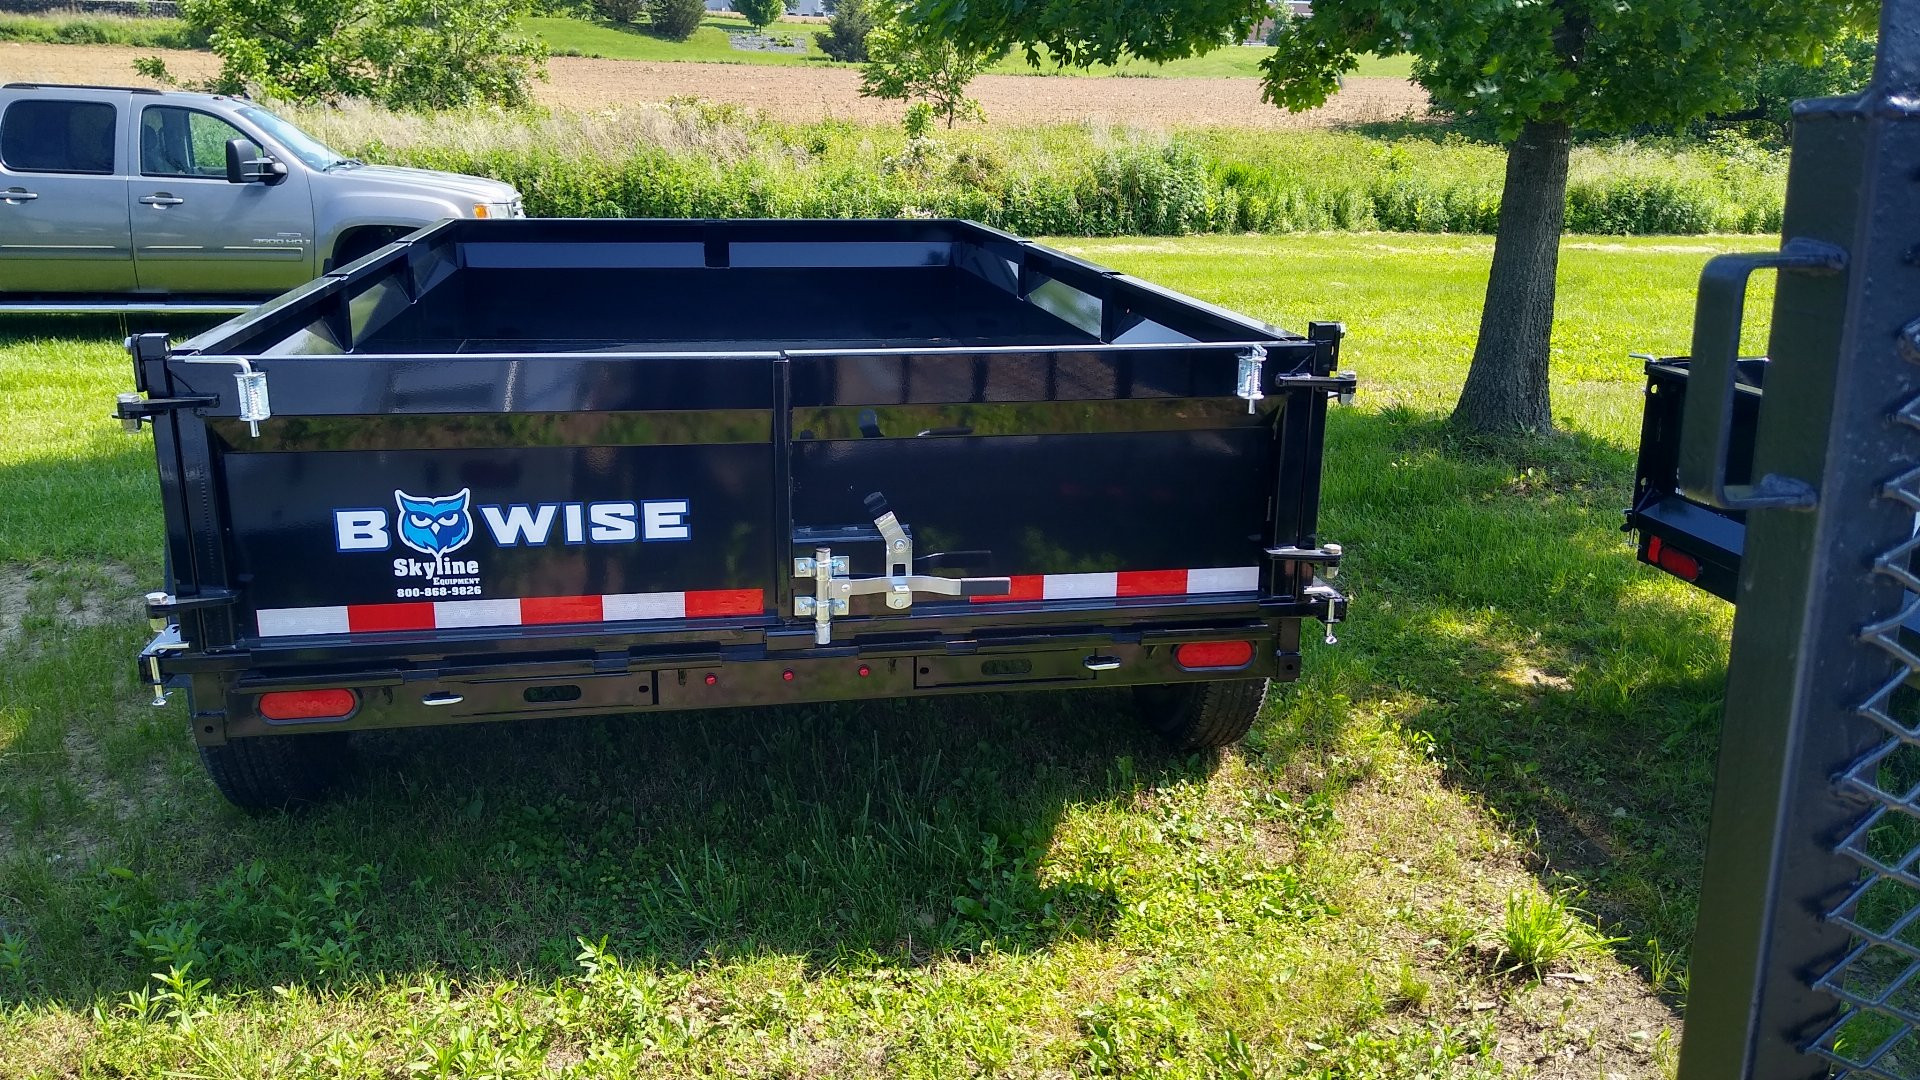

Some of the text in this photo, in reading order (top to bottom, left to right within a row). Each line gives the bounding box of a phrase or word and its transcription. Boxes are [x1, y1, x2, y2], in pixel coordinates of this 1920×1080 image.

[476, 499, 692, 547] WISE
[393, 557, 479, 579] Skyline
[396, 586, 482, 598] 800-868-9826
